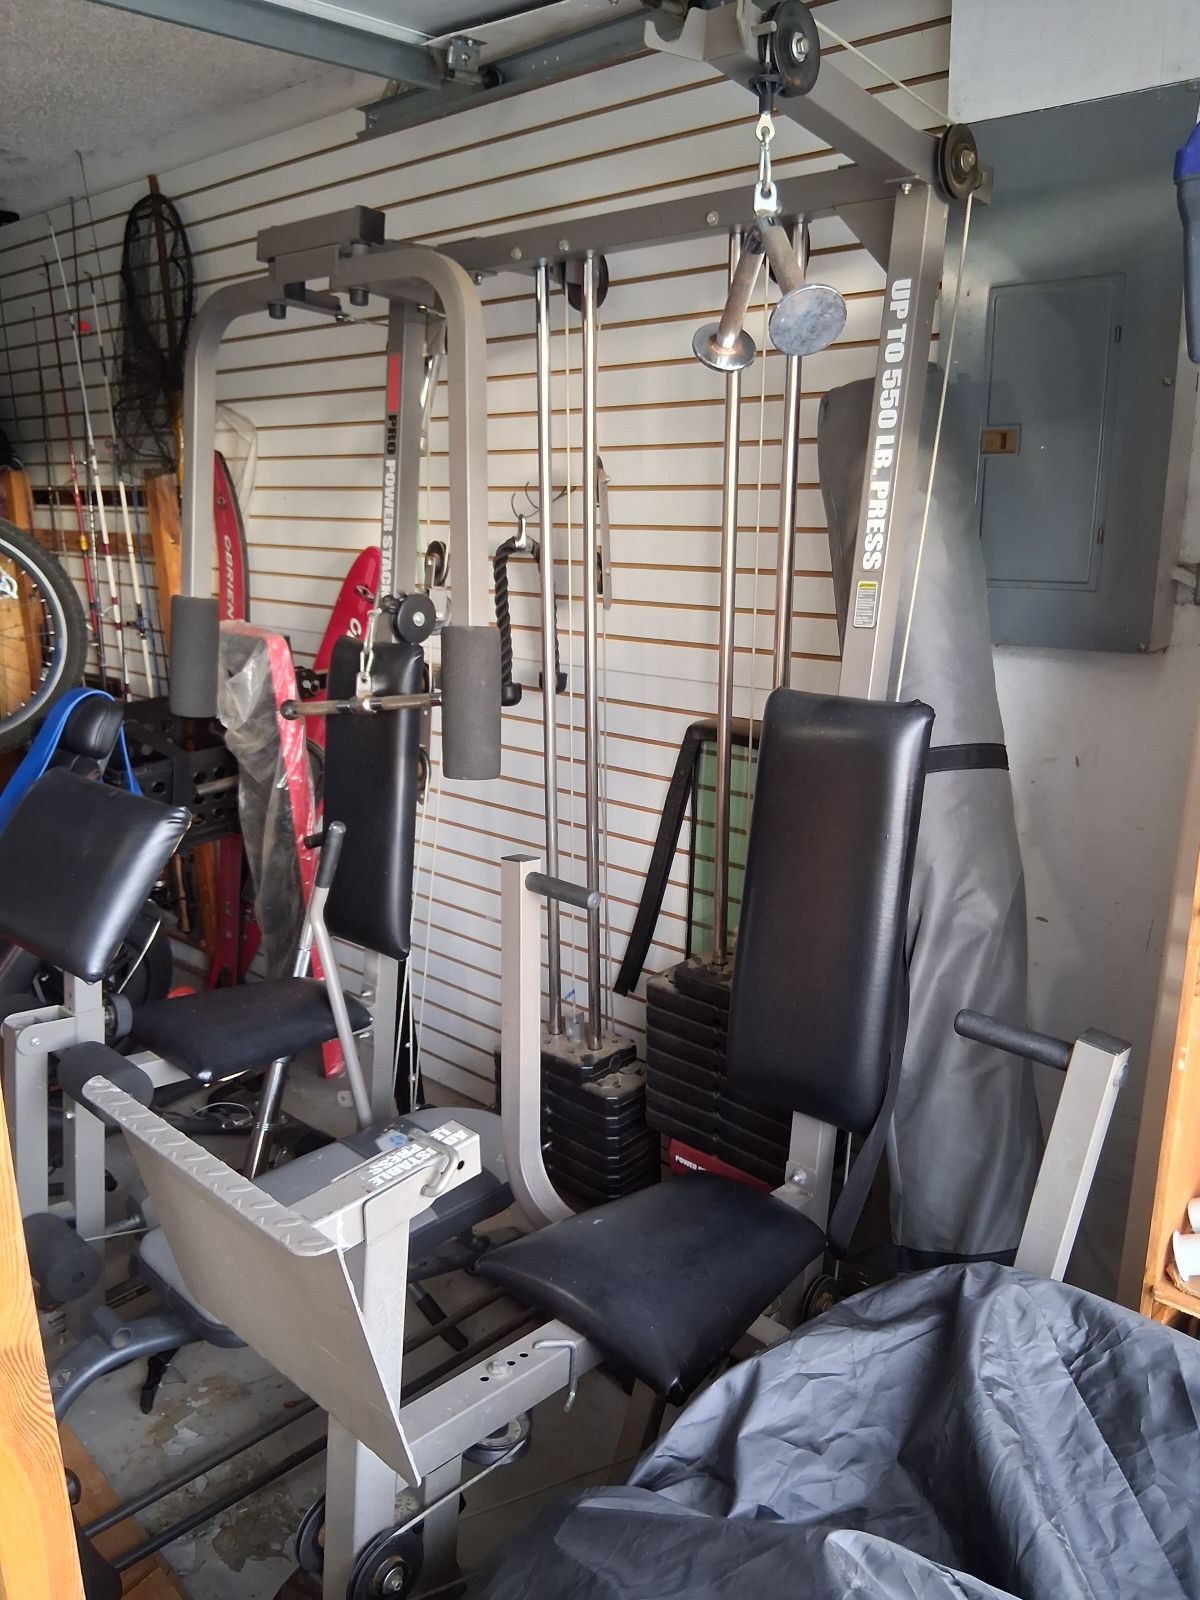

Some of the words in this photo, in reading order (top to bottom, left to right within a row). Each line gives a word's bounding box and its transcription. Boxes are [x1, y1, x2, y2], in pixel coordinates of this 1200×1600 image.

[889, 278, 912, 320] UP
[885, 323, 907, 363] TO
[877, 369, 902, 429] 550
[386, 414, 398, 455] PRO
[872, 435, 894, 476] LB.
[383, 459, 396, 532] POWER
[862, 480, 889, 571] PRESS
[368, 1143, 423, 1175] PRESS
[675, 1155, 698, 1171] POWER
